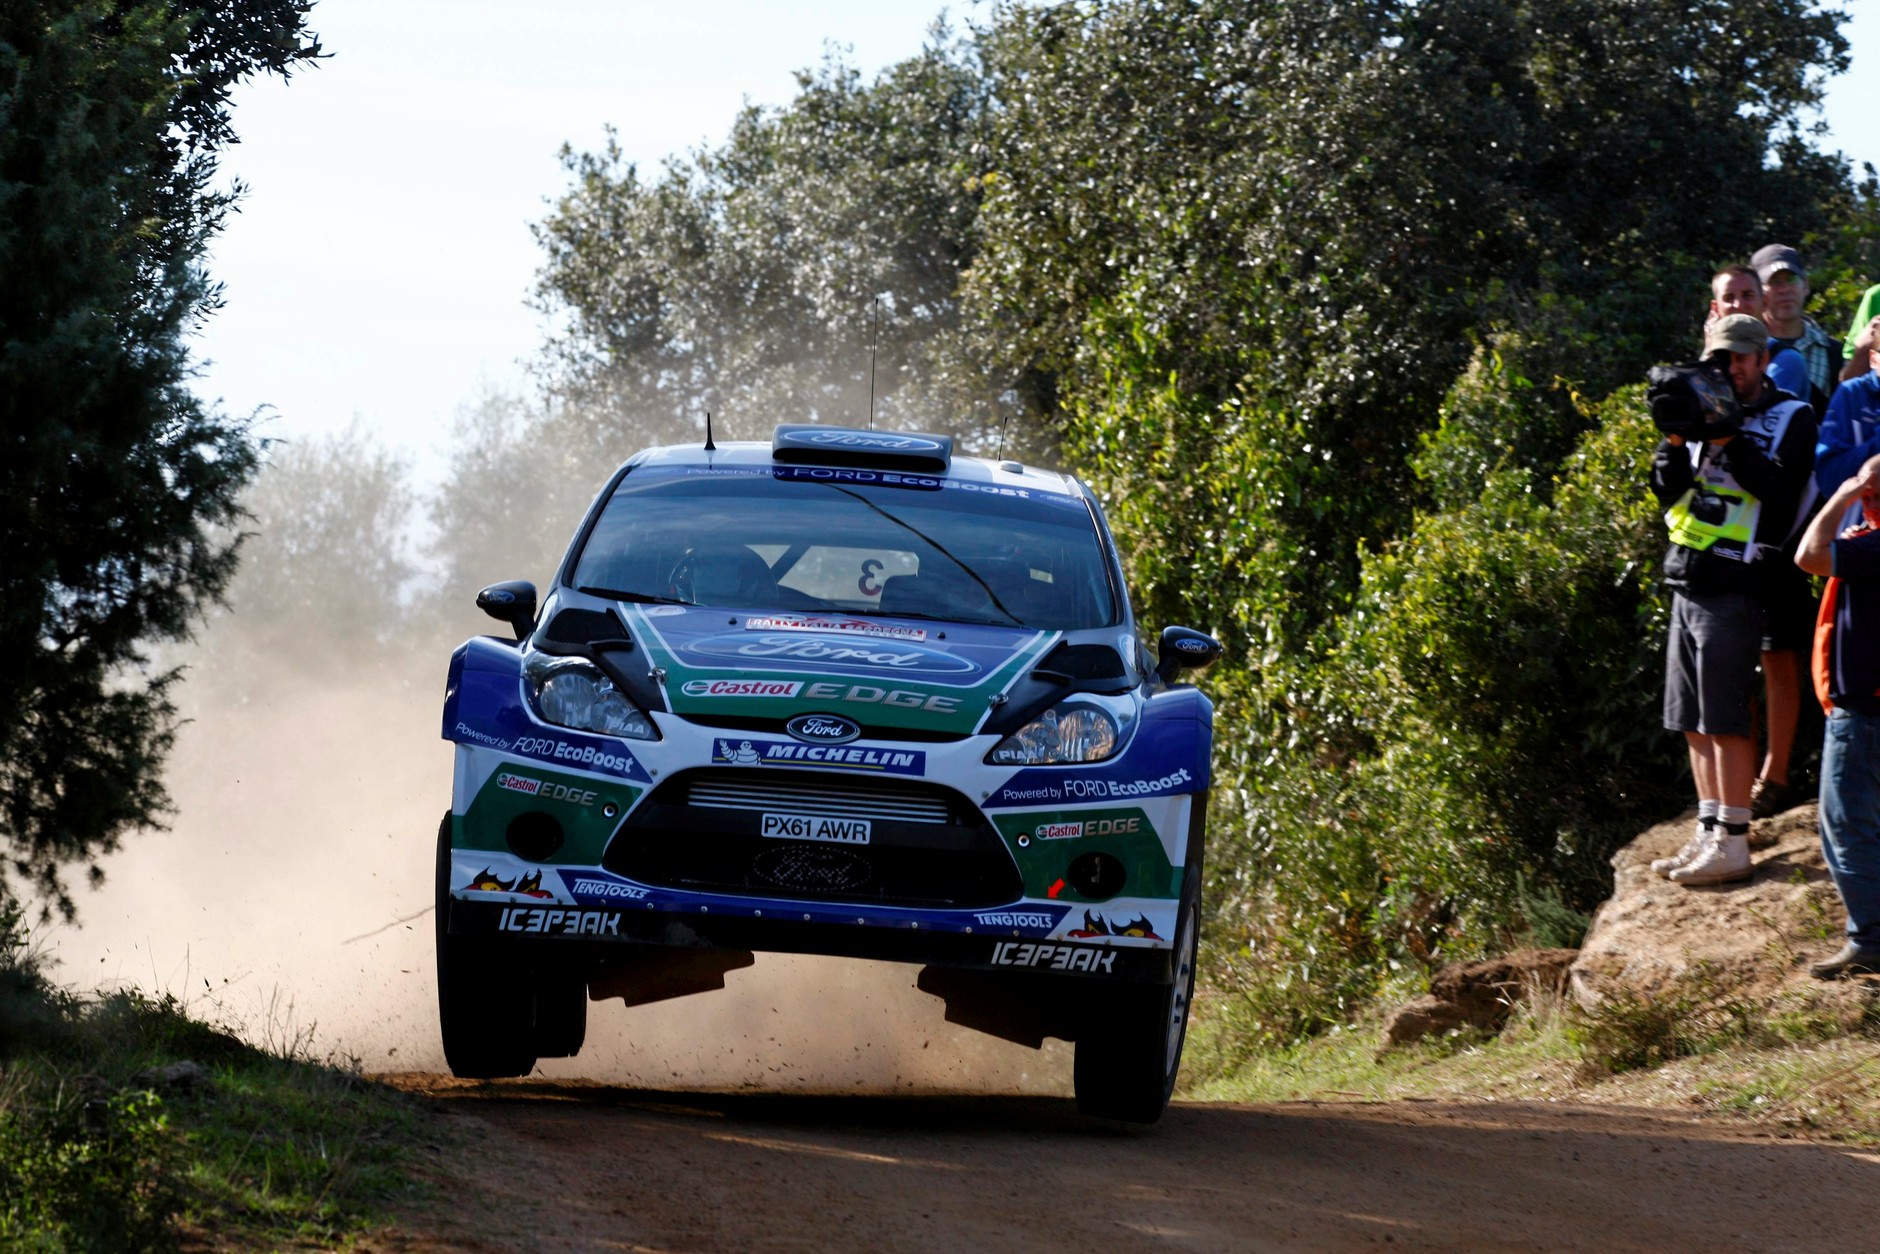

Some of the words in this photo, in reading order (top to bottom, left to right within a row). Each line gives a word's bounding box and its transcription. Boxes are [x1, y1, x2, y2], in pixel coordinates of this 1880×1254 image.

[812, 431, 912, 450] Ford
[766, 469, 785, 477] by
[793, 468, 877, 481] FORD
[881, 474, 1030, 499] EcoBoost
[753, 619, 795, 628] RALLY
[799, 622, 842, 630] ITALIA
[845, 625, 919, 636] SARDEGNA
[738, 636, 924, 667] Ford
[1182, 639, 1203, 651] Ford
[709, 681, 796, 696] Castrol
[803, 682, 965, 714] EDGE
[612, 717, 645, 734] PIAA
[801, 718, 843, 737] Ford
[455, 722, 498, 746] Powered
[498, 737, 511, 749] by
[512, 736, 554, 756] FORD
[553, 741, 634, 774] EcoBoost
[766, 745, 916, 767] MICHELIN
[1000, 751, 1039, 760] PIAA
[506, 776, 539, 793] Castrol
[539, 782, 598, 806] EDGE
[1003, 787, 1049, 800] Powered
[1050, 787, 1062, 798] by
[1064, 780, 1107, 797] FORD
[1109, 768, 1192, 796] EcoBoost
[764, 816, 811, 837] PX61
[816, 820, 867, 841] AWR
[1048, 824, 1081, 838] Castrol
[1084, 817, 1141, 836] EDGE
